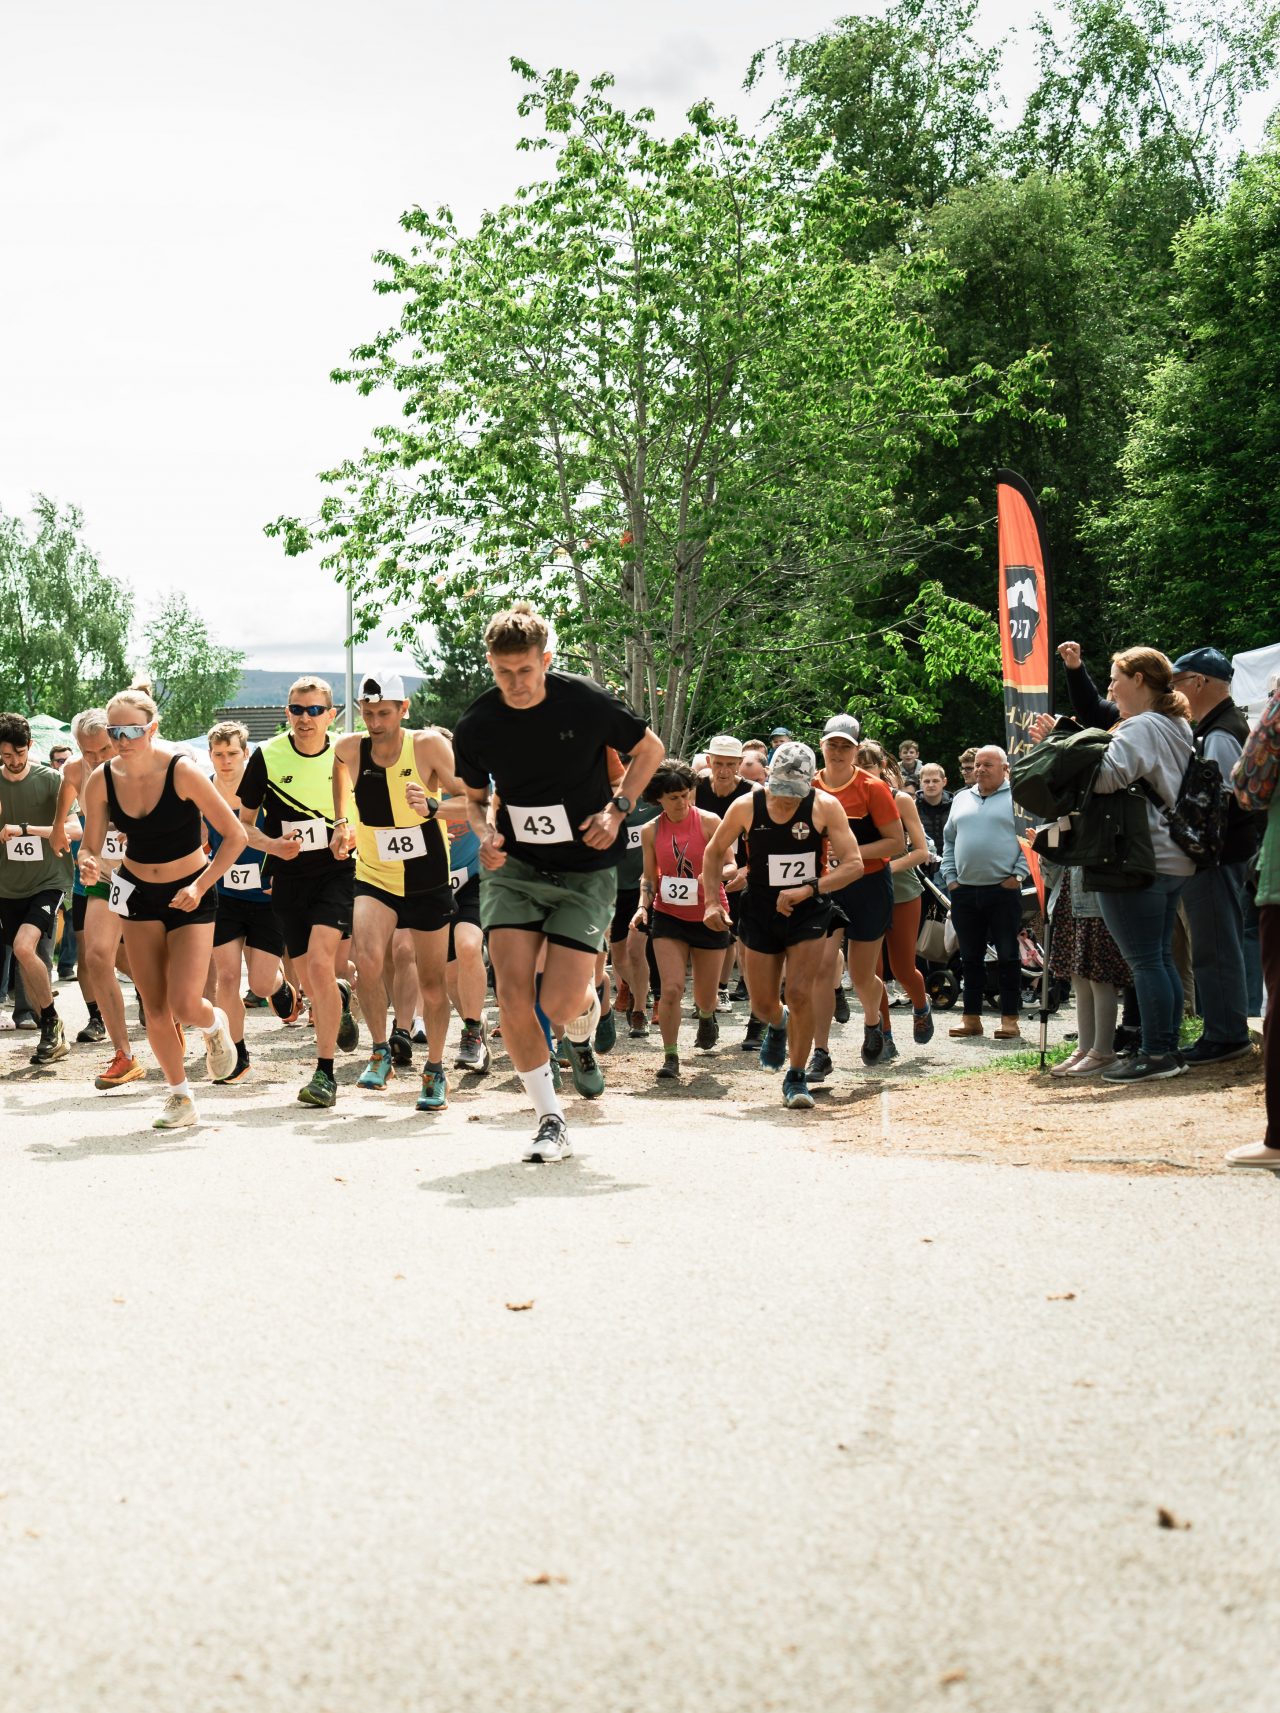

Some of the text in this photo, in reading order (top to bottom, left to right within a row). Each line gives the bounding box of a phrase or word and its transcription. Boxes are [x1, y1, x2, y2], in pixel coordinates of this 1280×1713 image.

[524, 816, 556, 835] 43
[14, 843, 34, 855] 46
[387, 836, 414, 854] 48
[231, 870, 250, 884] 67
[780, 862, 805, 879] 72
[669, 884, 689, 900] 32
